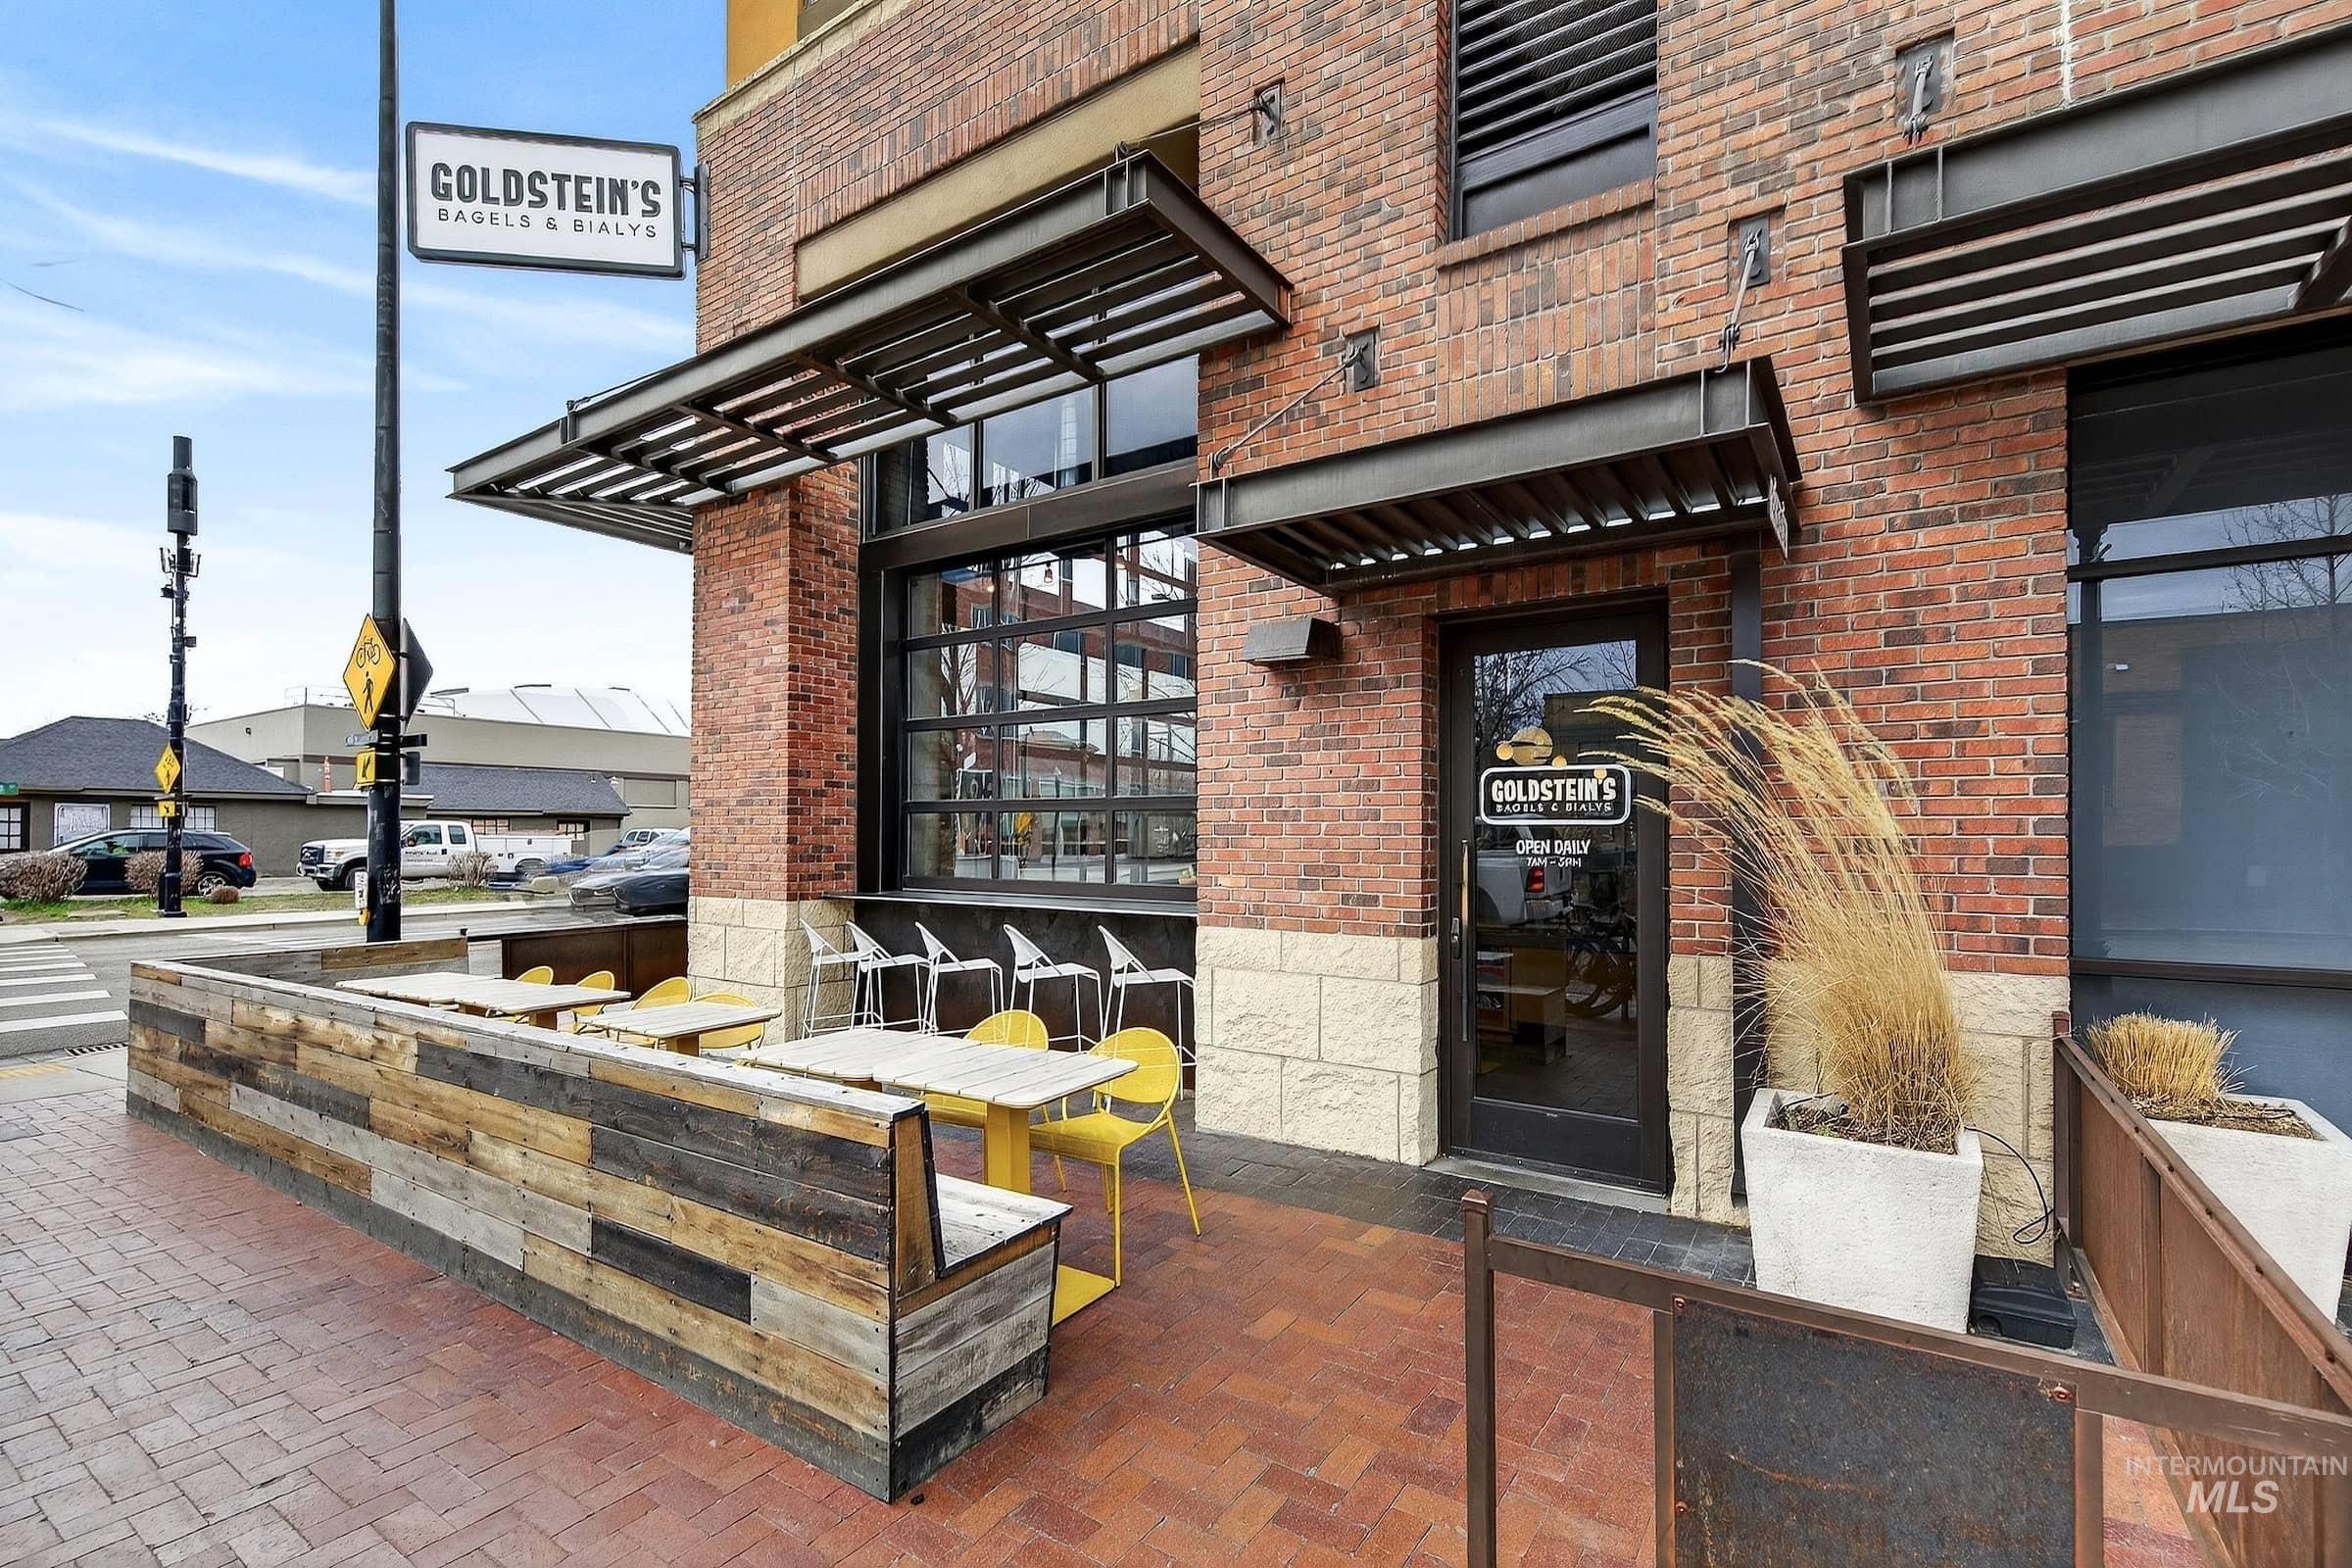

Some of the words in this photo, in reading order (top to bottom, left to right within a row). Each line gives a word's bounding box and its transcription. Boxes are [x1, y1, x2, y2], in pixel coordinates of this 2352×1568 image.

[431, 162, 662, 218] GOLDSTEIN'S
[438, 208, 531, 228] BAGELS
[546, 217, 559, 231] &
[574, 219, 657, 238] BIALYS
[1492, 777, 1616, 803] GOLDSTEIN'S
[1516, 839, 1550, 855] OPEN
[1554, 839, 1591, 856] DAILY
[1527, 857, 1547, 867] 7AM
